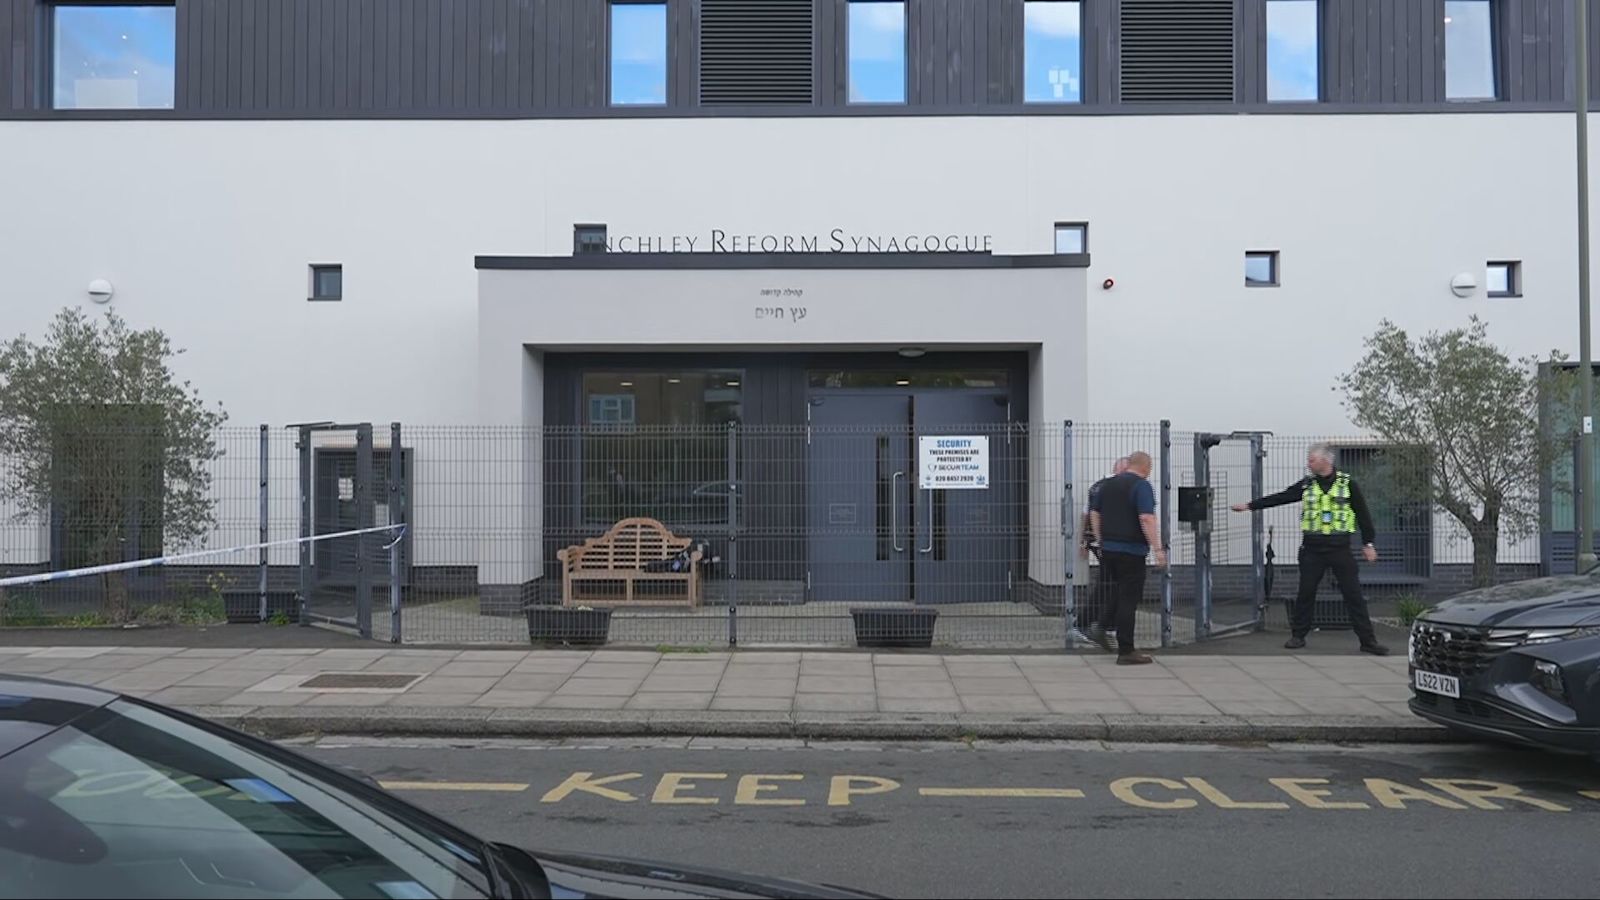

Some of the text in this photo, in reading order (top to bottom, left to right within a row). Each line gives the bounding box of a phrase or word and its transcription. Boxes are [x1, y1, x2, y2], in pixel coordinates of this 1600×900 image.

[711, 229, 817, 252] REFORM
[830, 229, 992, 252] SYNAGOGUE
[755, 307, 807, 323] עץ חיים
[937, 440, 972, 448] SECURITY
[1418, 672, 1456, 694] LS22 VZN
[540, 772, 1571, 811] KEEP CLEAR
